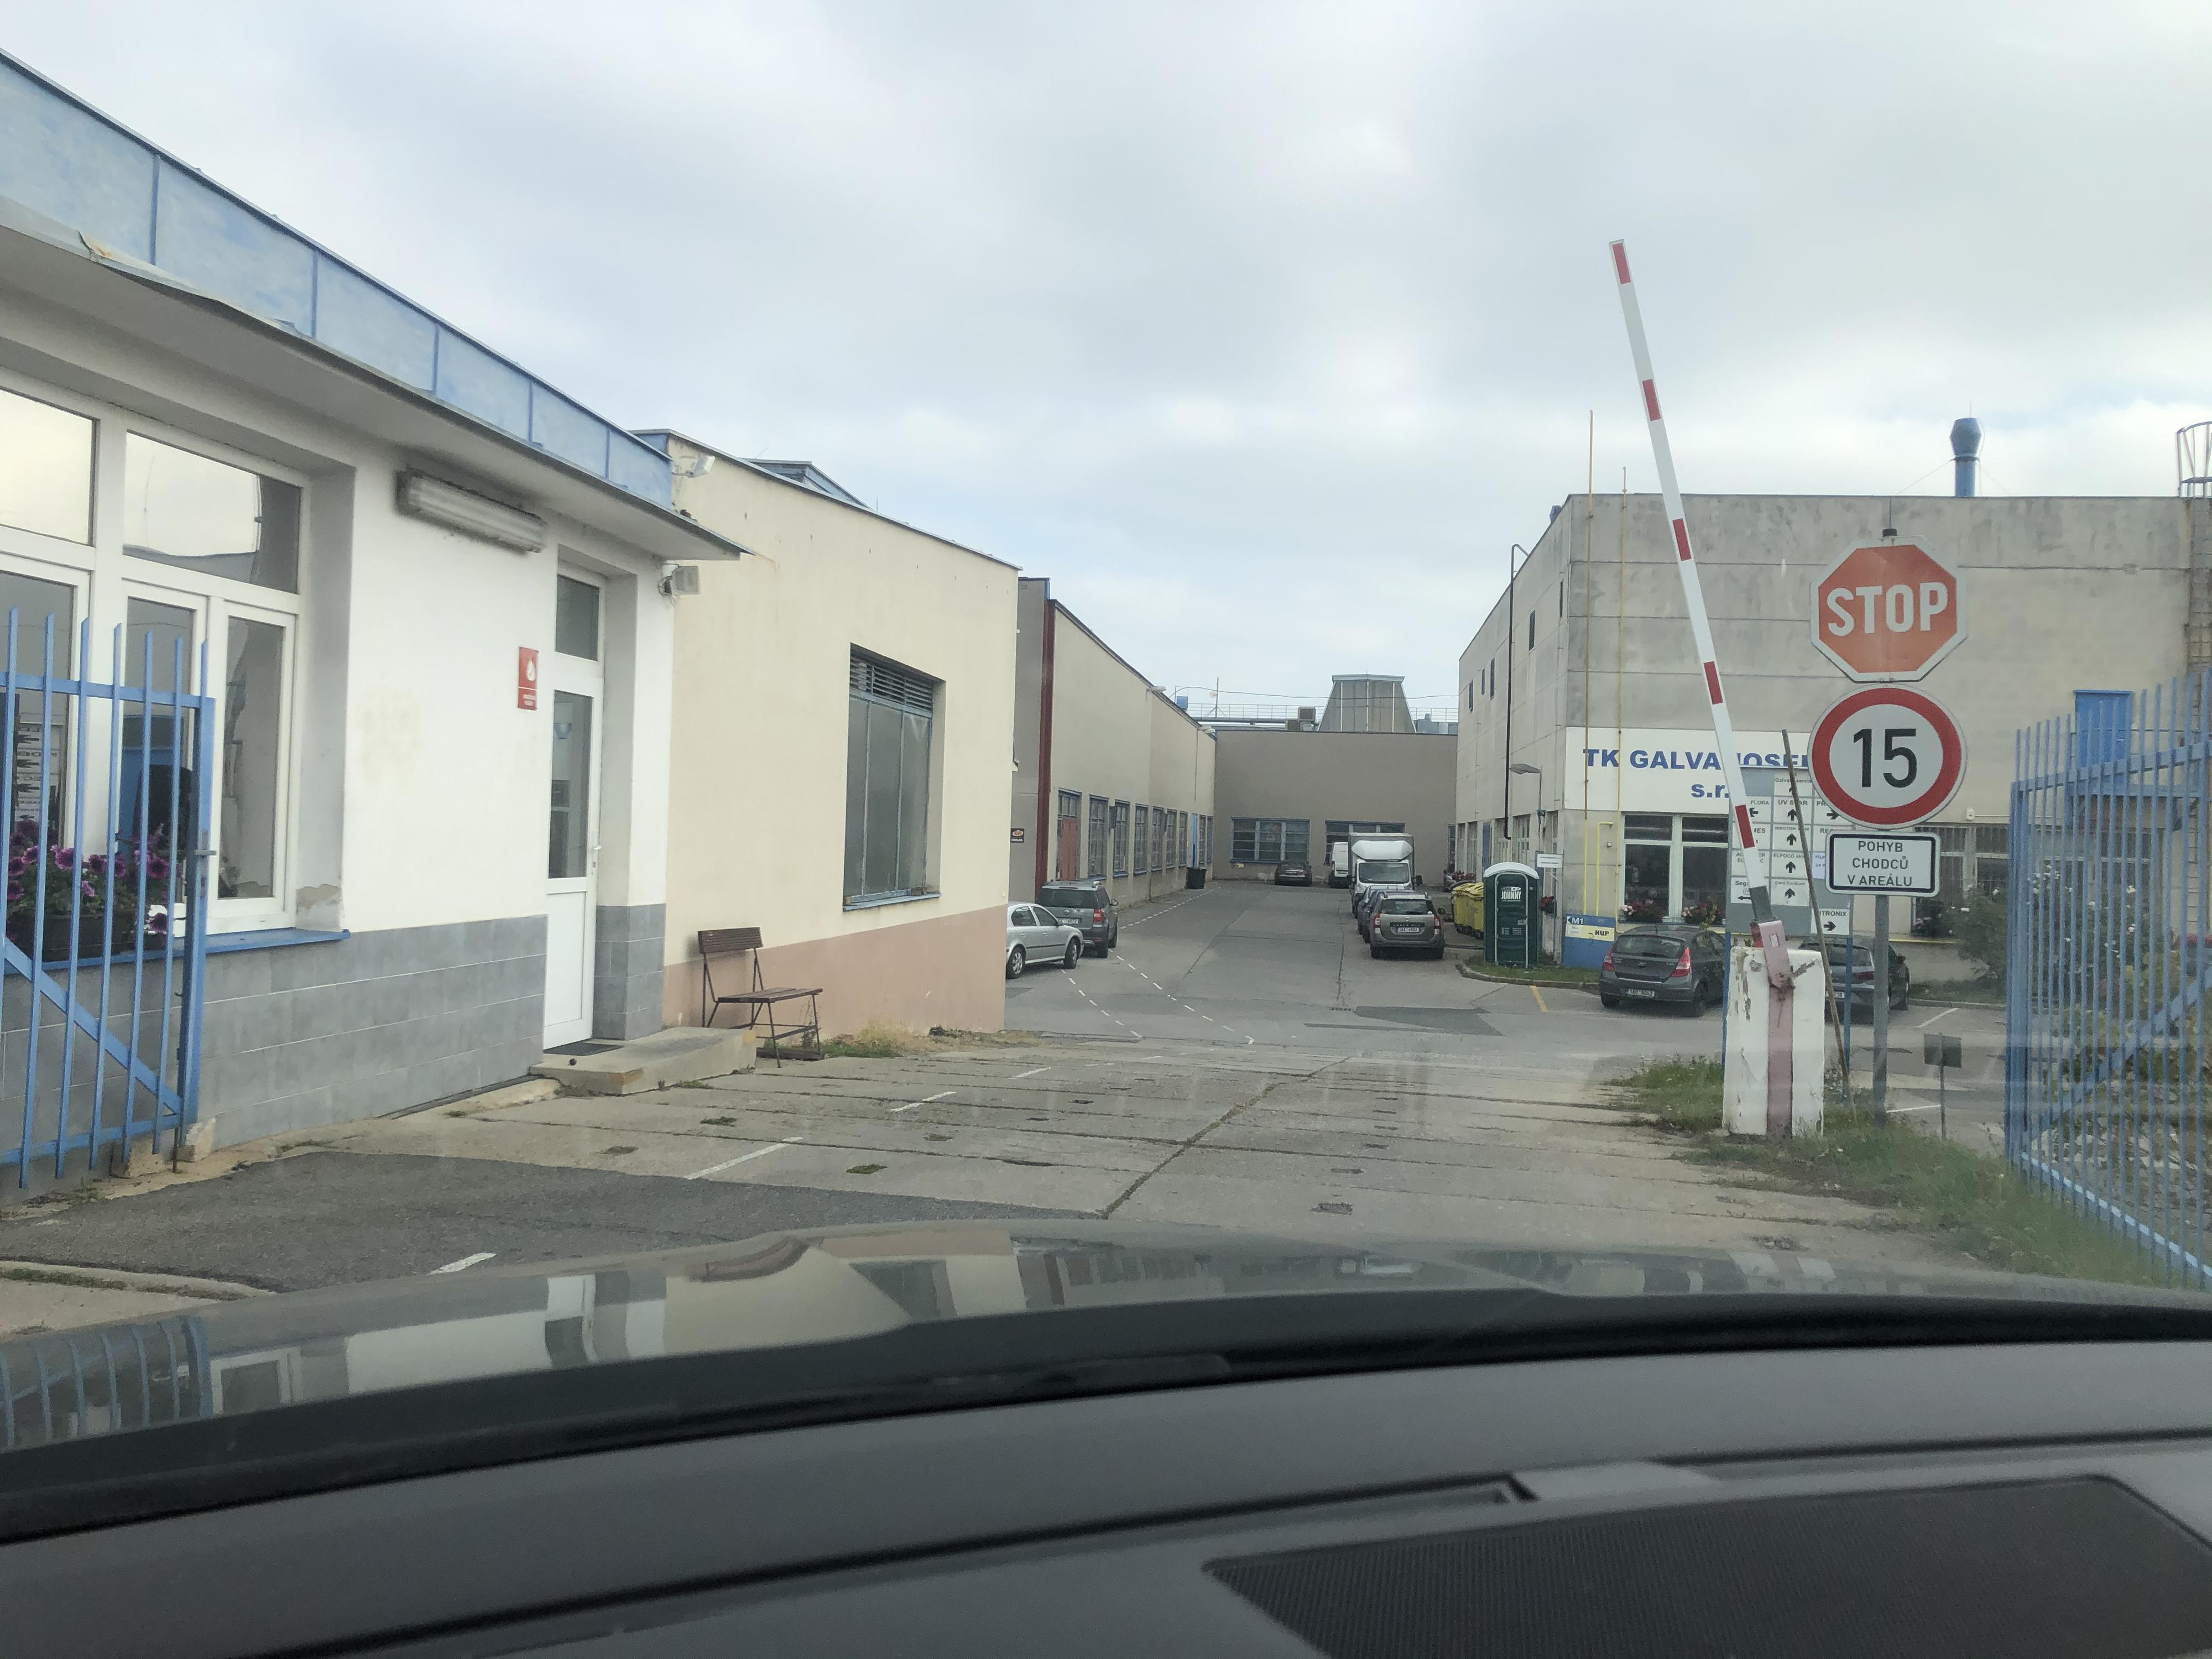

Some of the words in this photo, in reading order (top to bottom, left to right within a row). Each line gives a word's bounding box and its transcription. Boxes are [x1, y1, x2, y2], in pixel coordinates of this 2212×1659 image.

[1827, 582, 1948, 637] STOP
[1583, 749, 1620, 768] TK
[1853, 728, 1917, 788] 15
[1858, 841, 1903, 852] POHYB
[1852, 855, 1908, 869] CHODCŮ
[1847, 874, 1856, 885] V
[1859, 873, 1912, 886] AREÁLU
[1501, 891, 1522, 900] JOHNNY
